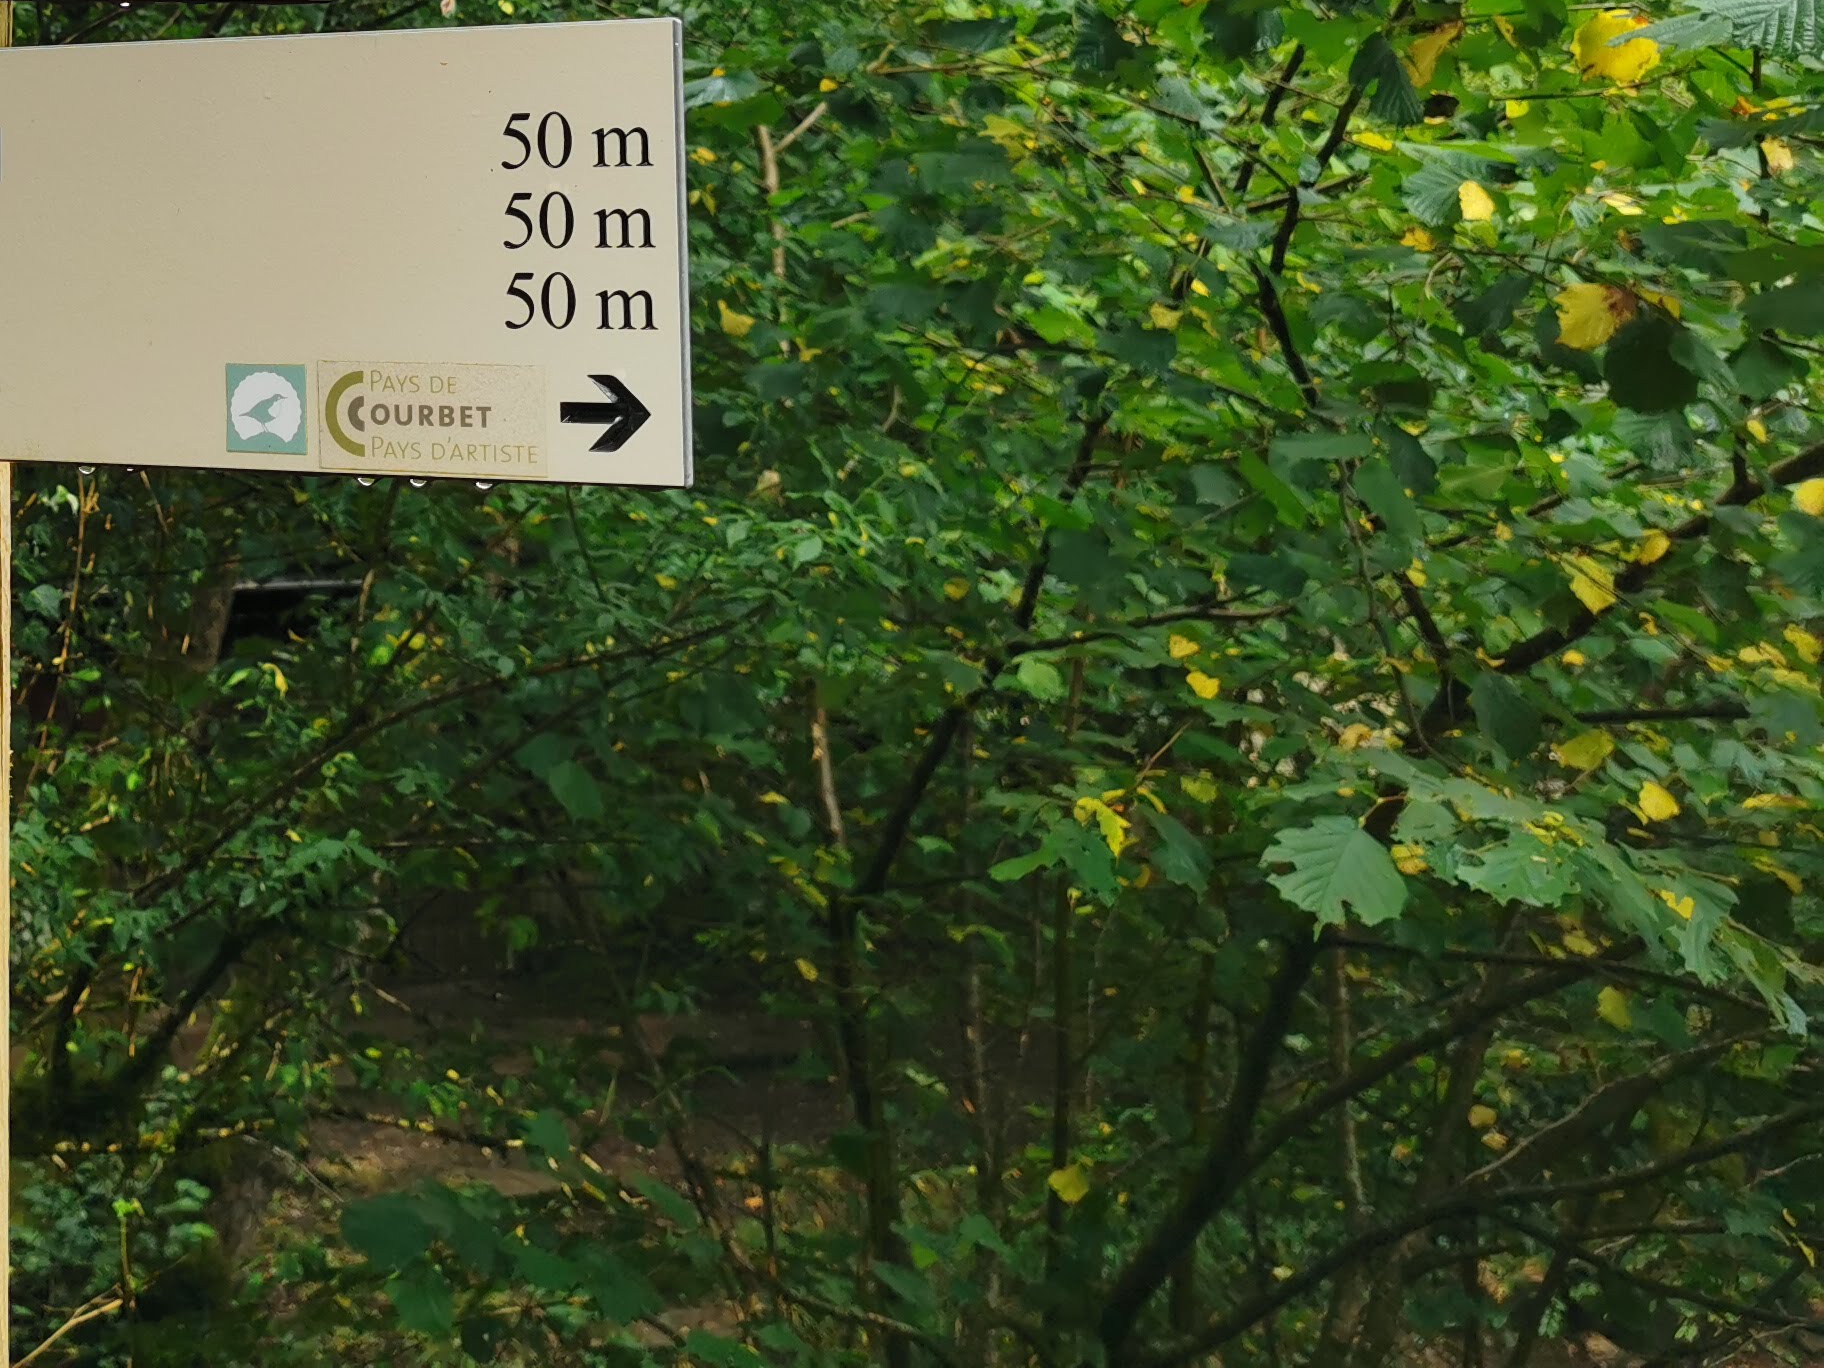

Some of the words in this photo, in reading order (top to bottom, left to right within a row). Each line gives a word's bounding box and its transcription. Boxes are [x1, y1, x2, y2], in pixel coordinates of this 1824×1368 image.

[501, 111, 572, 169] 50
[592, 127, 654, 167] m
[503, 191, 574, 249] 50
[594, 208, 656, 248] m
[505, 272, 576, 329] 50
[596, 290, 658, 330] m
[370, 370, 420, 393] PAYS
[430, 376, 457, 394] DE
[371, 436, 422, 459] PAYS
[431, 436, 538, 464] D'ARTISTE
